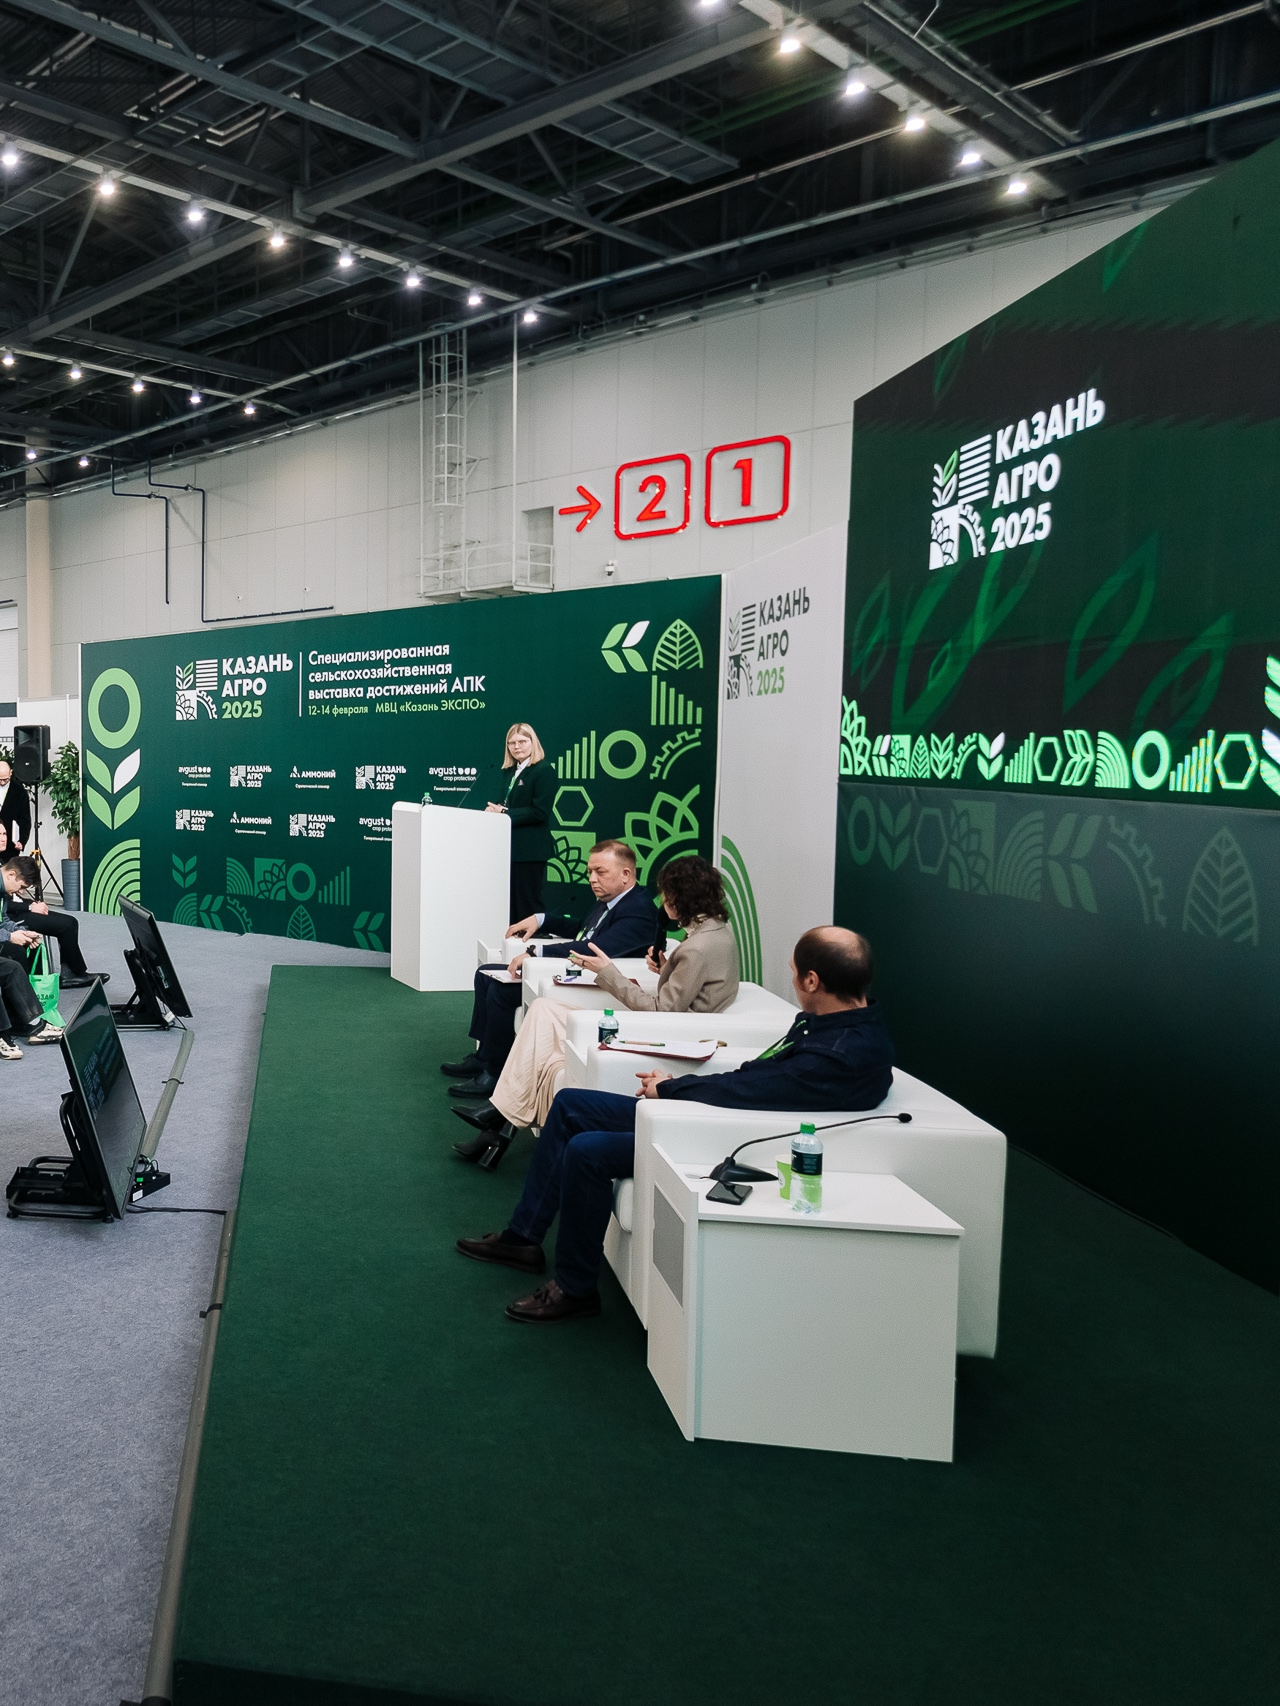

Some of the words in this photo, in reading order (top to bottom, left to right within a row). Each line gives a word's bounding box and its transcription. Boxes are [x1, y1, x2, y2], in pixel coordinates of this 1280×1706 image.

[995, 387, 1106, 465] КАЗАНЬ
[636, 474, 667, 522] 2
[732, 457, 753, 507] 1
[991, 452, 1061, 509] АГРО
[989, 501, 1053, 554] 2025
[758, 586, 811, 627] КАЗАНЬ
[308, 644, 450, 666] Специализированная
[756, 629, 790, 662] АГРО
[222, 653, 293, 676] КАЗАНЬ
[308, 662, 452, 683] сельскохозяйственная
[221, 677, 267, 697] АГРО
[308, 685, 364, 700] выставка
[366, 679, 448, 699] достижений
[450, 675, 486, 693] АПК
[756, 666, 786, 697] 2025
[221, 700, 263, 719] 2025
[308, 704, 330, 716] 12-14
[332, 703, 369, 717] февраля
[375, 701, 398, 715] МВЦ
[399, 700, 439, 713] «Казань
[440, 698, 486, 711] ЭКСПО»
[178, 765, 198, 775] avgust
[246, 765, 272, 773] КАЗАНЬ
[301, 769, 336, 778] АММОНИЙ
[376, 765, 406, 774] КАЗАНЬ
[376, 774, 396, 782] АГРО
[428, 766, 456, 777] avgust
[247, 780, 262, 788] 2025
[376, 782, 394, 790] 2025
[240, 816, 272, 825] АММОНИЙ
[308, 814, 336, 823] КАЗАНЬ
[359, 817, 384, 827] avgust
[308, 830, 325, 838] 2025
